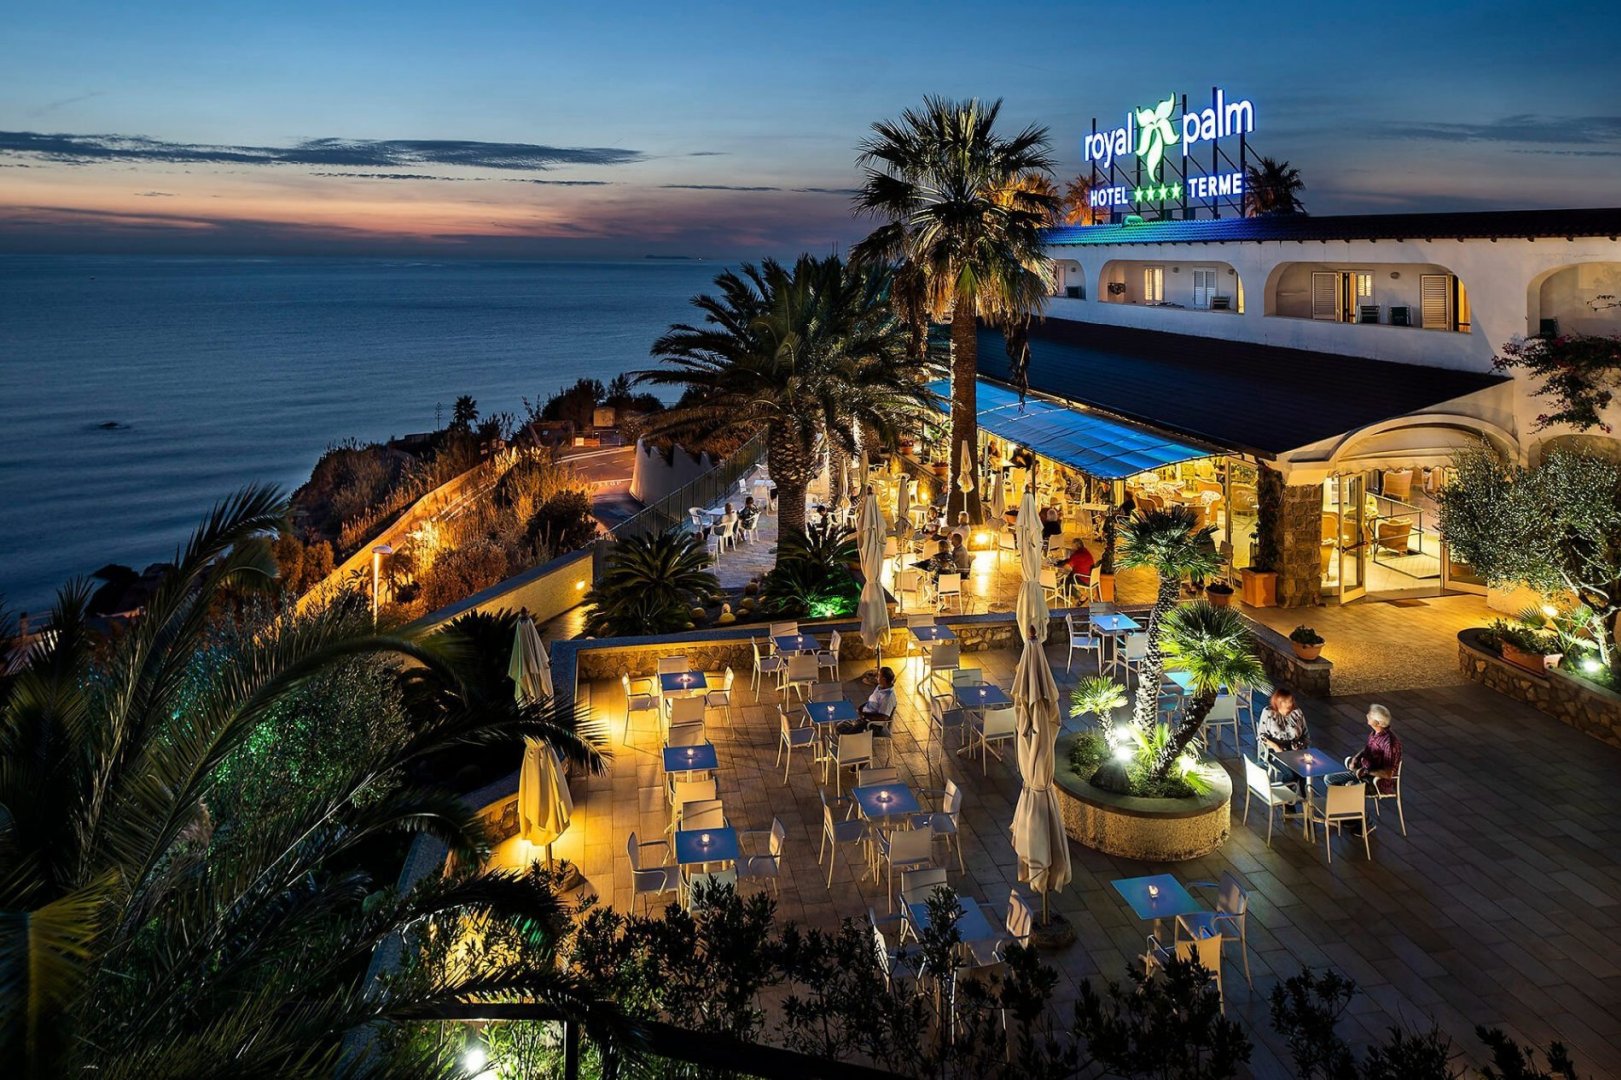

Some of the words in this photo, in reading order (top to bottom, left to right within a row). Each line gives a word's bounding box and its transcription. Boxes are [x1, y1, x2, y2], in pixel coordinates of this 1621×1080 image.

[1084, 112, 1133, 168] royal
[1182, 89, 1254, 156] palm
[1090, 186, 1129, 207] HOTEL
[1188, 173, 1243, 198] TERME
